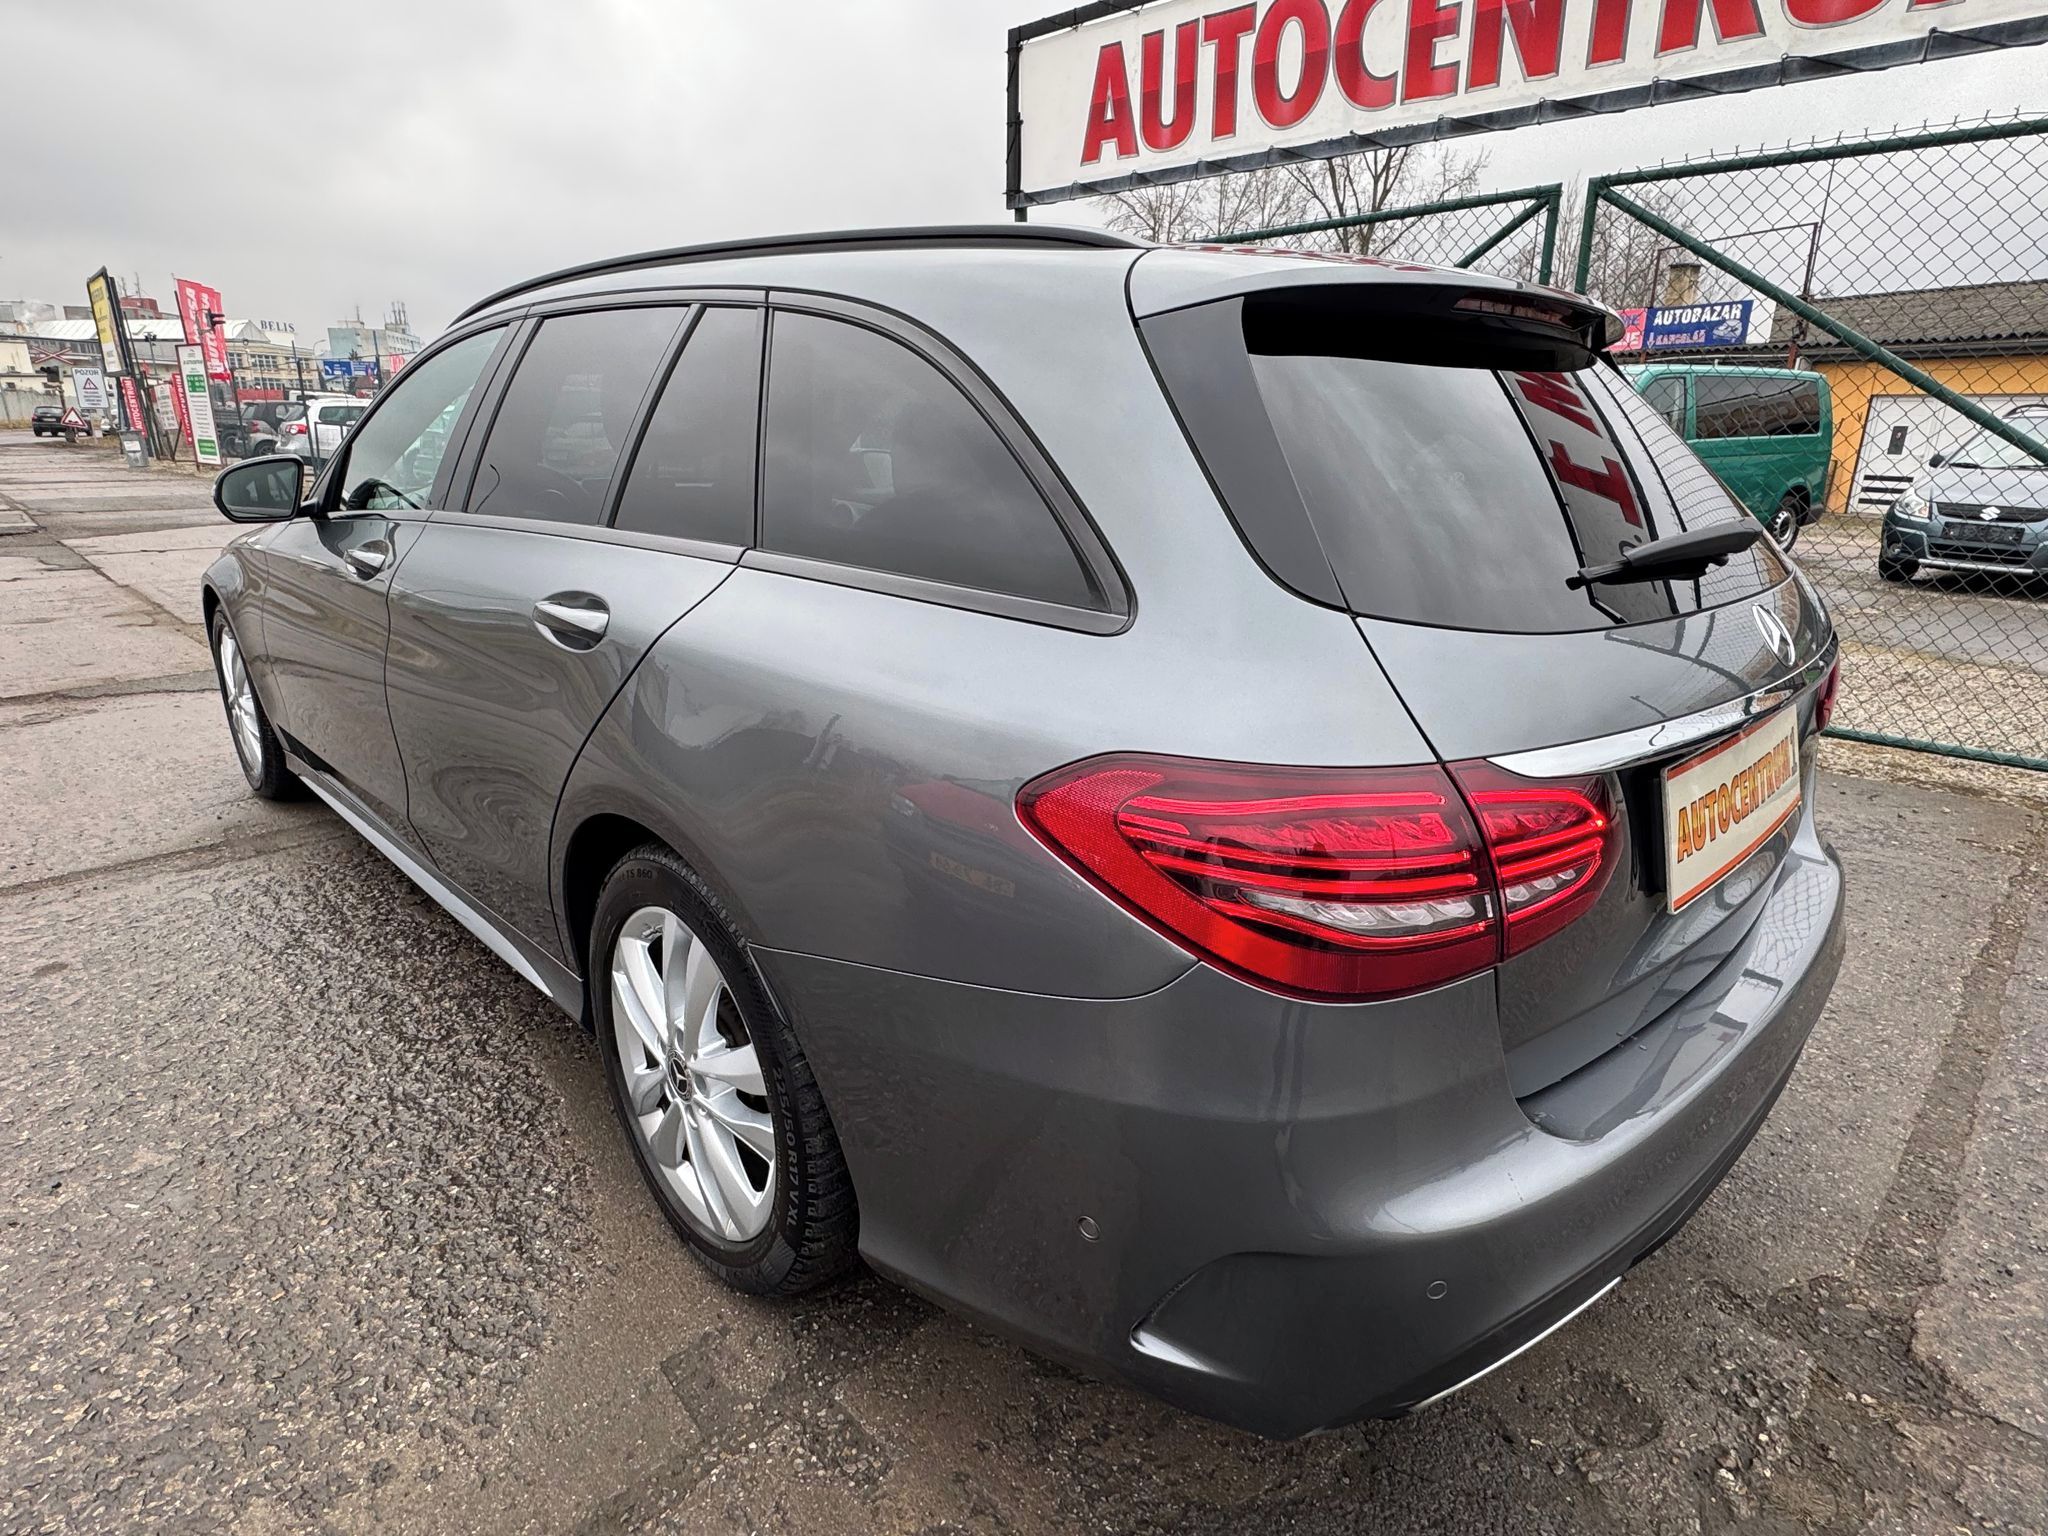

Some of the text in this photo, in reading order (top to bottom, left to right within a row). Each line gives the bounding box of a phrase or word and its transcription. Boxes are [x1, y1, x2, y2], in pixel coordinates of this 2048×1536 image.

[260, 320, 295, 332] BELIS
[1653, 304, 1743, 326] AUTOBAZAR
[124, 380, 143, 430] AUTOCENTRUM
[1677, 735, 1790, 864] AUTOCENTRUM
[637, 868, 653, 880] 860
[771, 1066, 796, 1146] 225/50
[786, 1149, 799, 1186] R17
